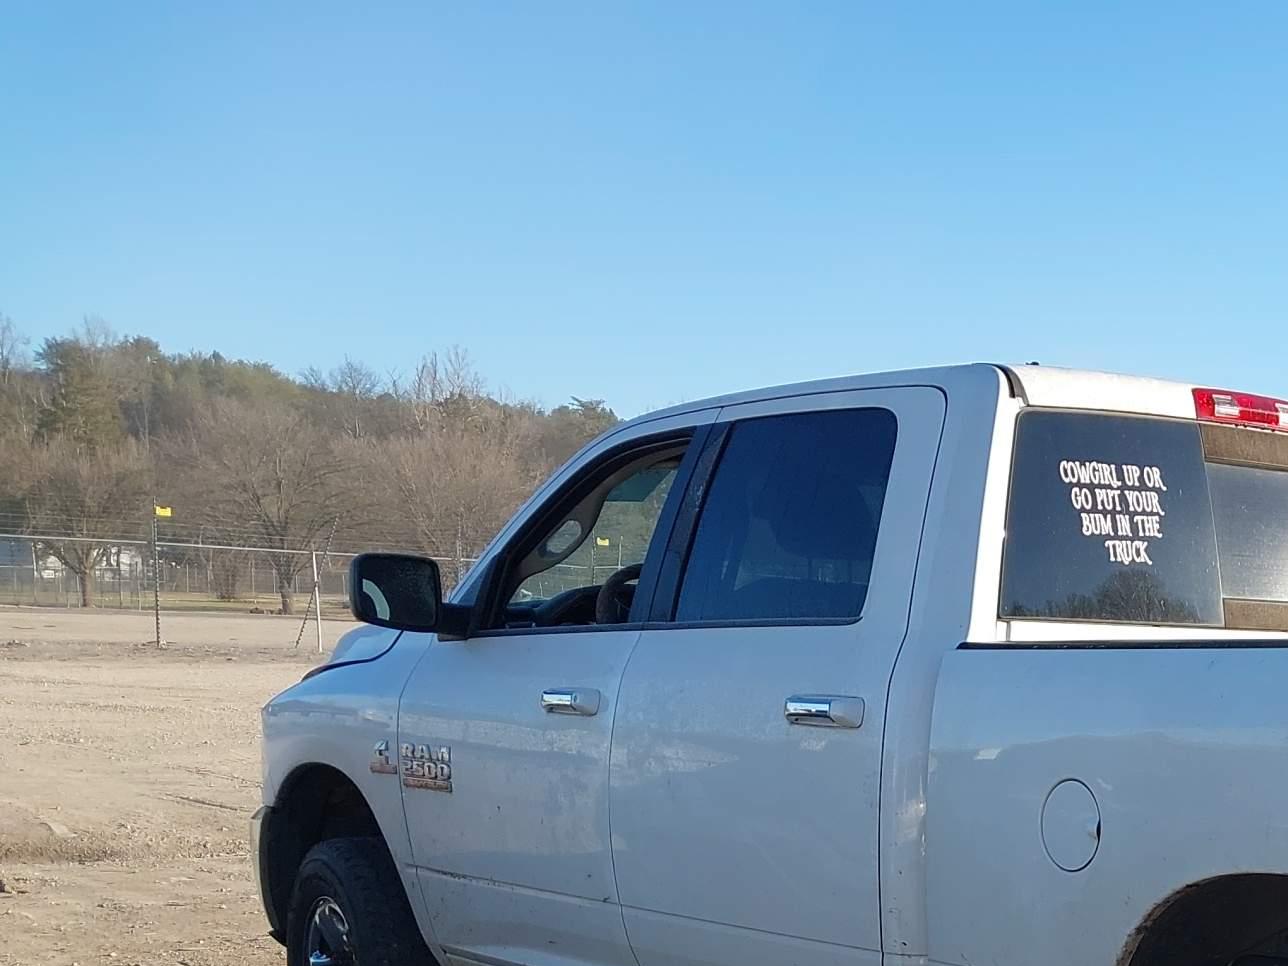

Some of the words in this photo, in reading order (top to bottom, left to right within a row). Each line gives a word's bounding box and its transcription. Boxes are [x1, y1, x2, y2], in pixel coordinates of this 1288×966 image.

[1060, 460, 1121, 488] COWGIRL
[1122, 465, 1140, 486] UP
[1144, 466, 1167, 491] OR
[1071, 487, 1092, 510] GO
[1094, 489, 1121, 511] PUT
[1124, 490, 1165, 516] YOUR
[1080, 512, 1114, 536] BUM
[1116, 514, 1132, 537] IN
[1134, 515, 1163, 538] THE
[1104, 540, 1152, 565] TRUCK
[401, 743, 452, 762] RAM
[400, 759, 452, 781] 2500
